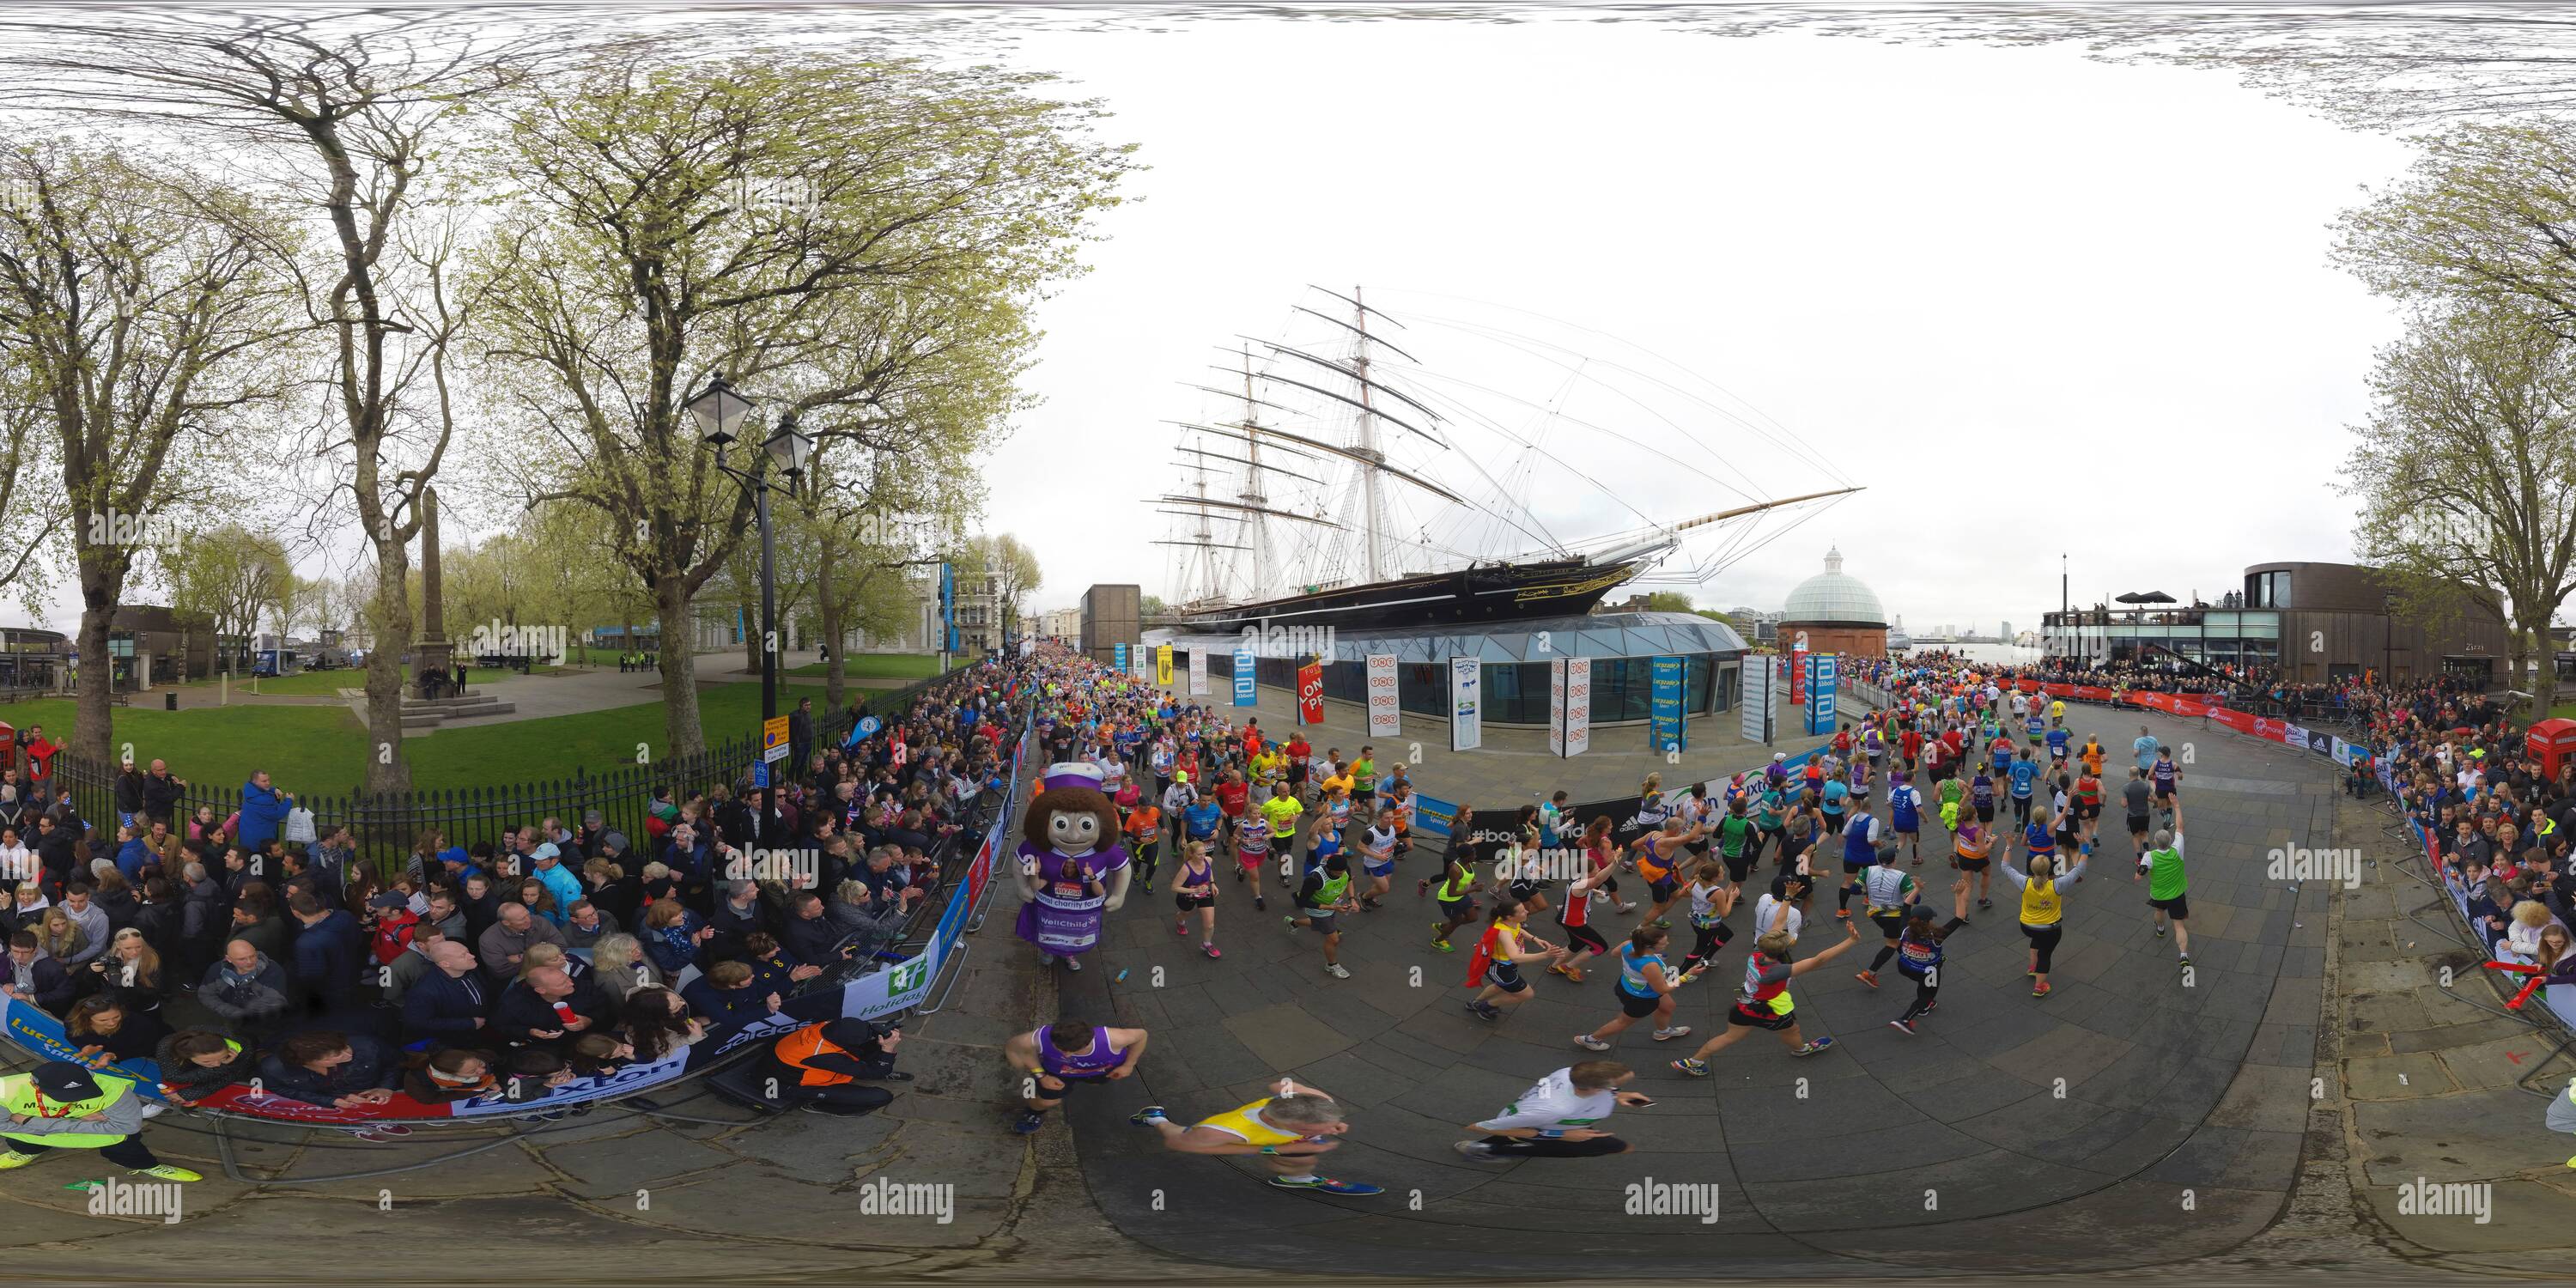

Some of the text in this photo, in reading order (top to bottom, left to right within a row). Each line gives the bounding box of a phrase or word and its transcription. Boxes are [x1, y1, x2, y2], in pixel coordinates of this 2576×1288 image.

[1571, 662, 1589, 674] TNT
[1371, 677, 1395, 686] TNT
[1570, 684, 1588, 697] TNT
[1372, 696, 1396, 705] TNT
[1569, 706, 1588, 720] TNT
[1373, 715, 1397, 724] TNT
[1569, 728, 1587, 742] TNT
[2267, 726, 2284, 736] money
[860, 992, 924, 1016] Holiday
[714, 1018, 812, 1055] adidas
